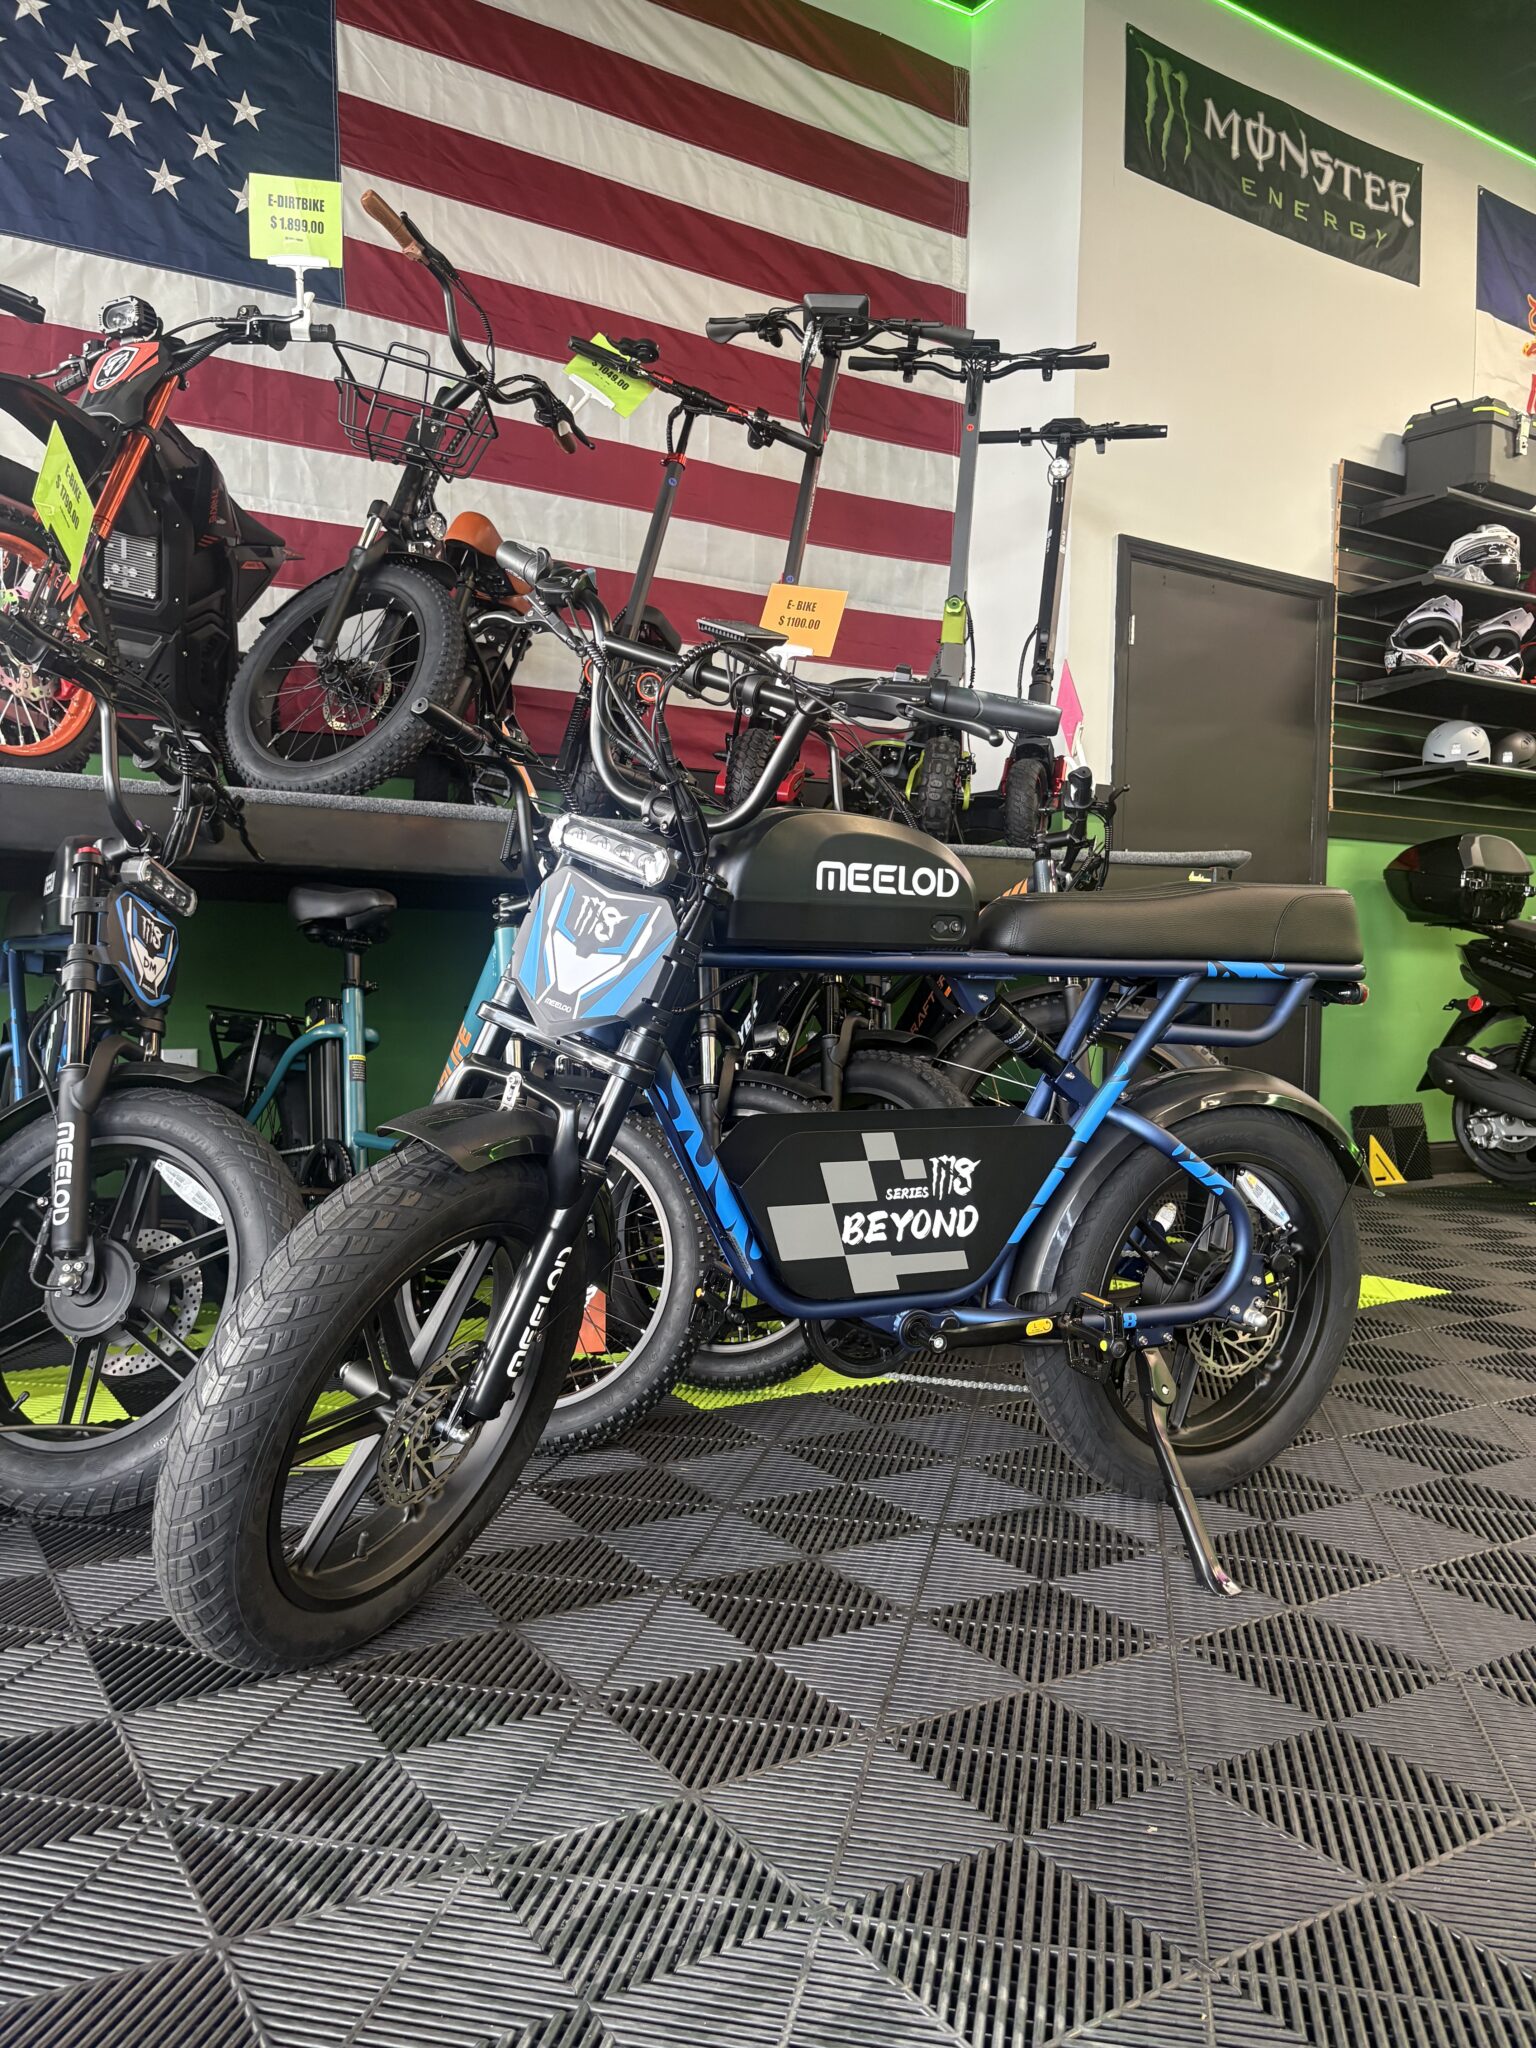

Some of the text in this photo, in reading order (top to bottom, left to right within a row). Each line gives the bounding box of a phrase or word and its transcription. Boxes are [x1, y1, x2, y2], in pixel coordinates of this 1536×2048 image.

[1204, 98, 1414, 228] MONSTER
[267, 193, 325, 213] E-DIRTBIKE
[1241, 177, 1388, 248] ENERGY
[598, 363, 630, 391] 1049.00
[64, 464, 82, 504] E-BIKE
[786, 616, 821, 630] 1100.00
[816, 860, 960, 898] MEELOD
[544, 998, 573, 1014] MEELOD
[52, 1121, 76, 1226] MEELOD
[886, 1186, 930, 1201] SERIES
[842, 1204, 979, 1246] BEYOND
